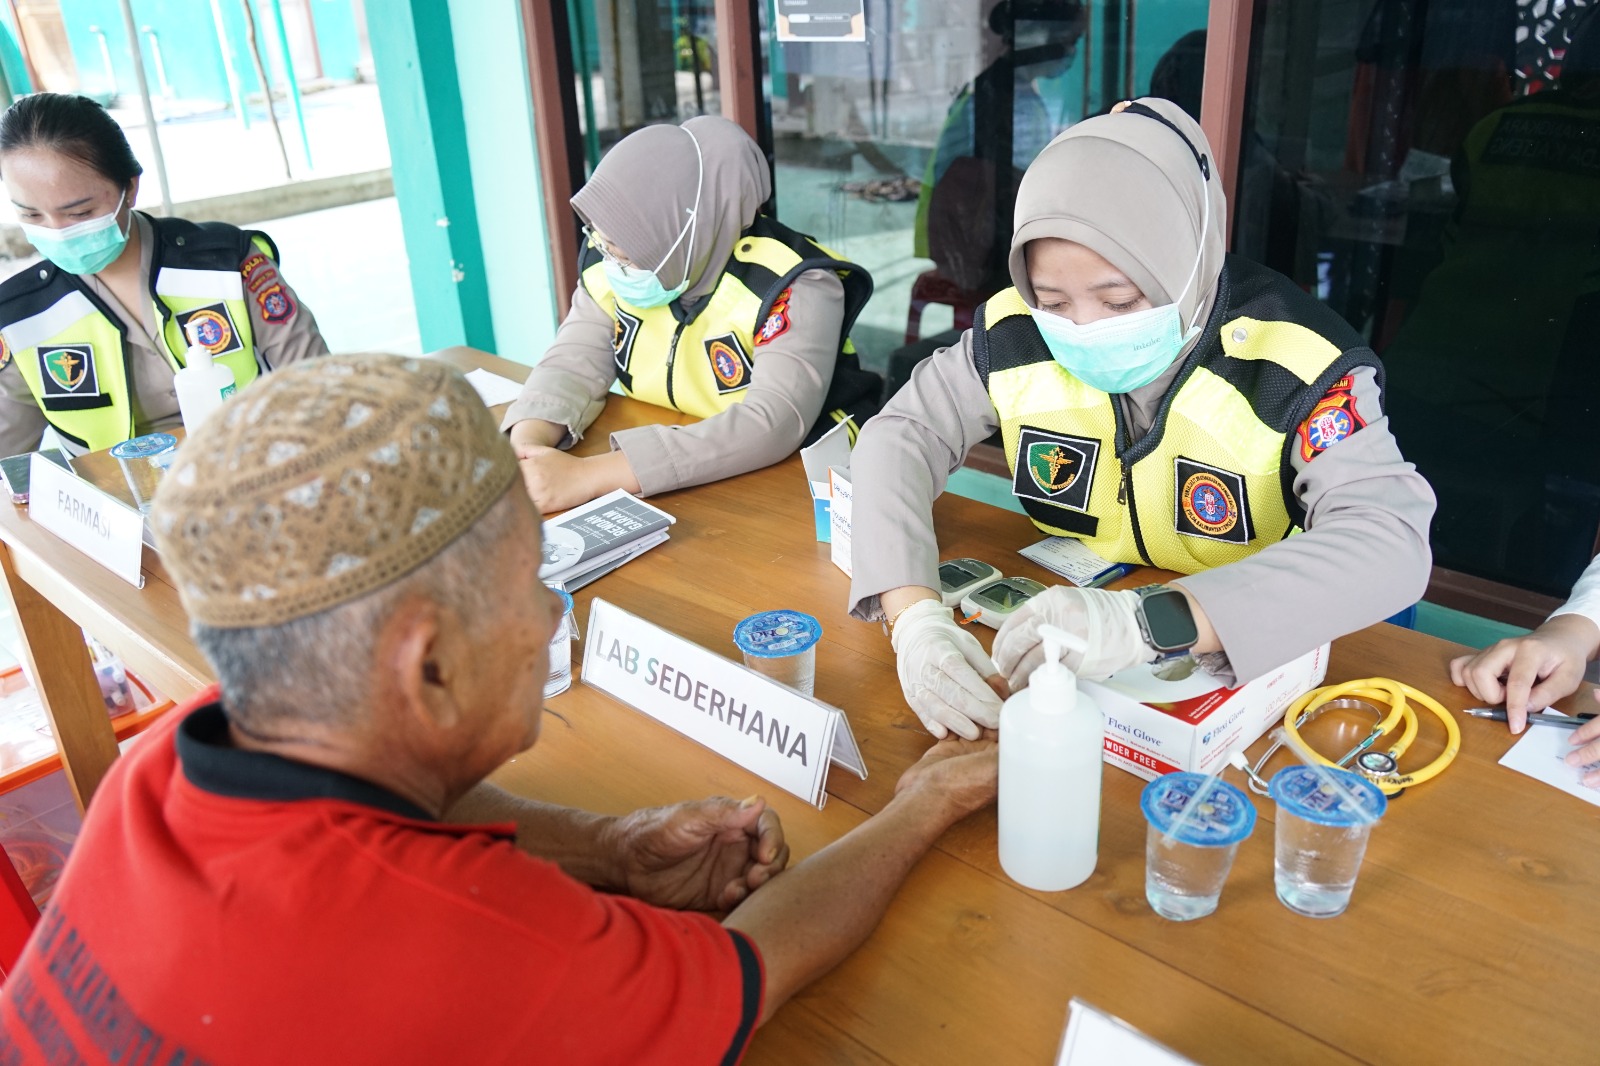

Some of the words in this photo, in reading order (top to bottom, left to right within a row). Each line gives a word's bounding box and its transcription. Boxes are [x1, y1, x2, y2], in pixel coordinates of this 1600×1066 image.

[242, 257, 263, 278] POLDA
[57, 489, 111, 541] FARMASI
[584, 514, 628, 537] RENDAH
[602, 510, 643, 530] GARAM
[595, 630, 640, 675] LAB
[644, 657, 807, 767] SEDERHANA
[1108, 717, 1131, 734] Flexi
[1133, 728, 1162, 747] Glove
[1104, 739, 1130, 758] WDER
[1133, 752, 1157, 769] FREE
